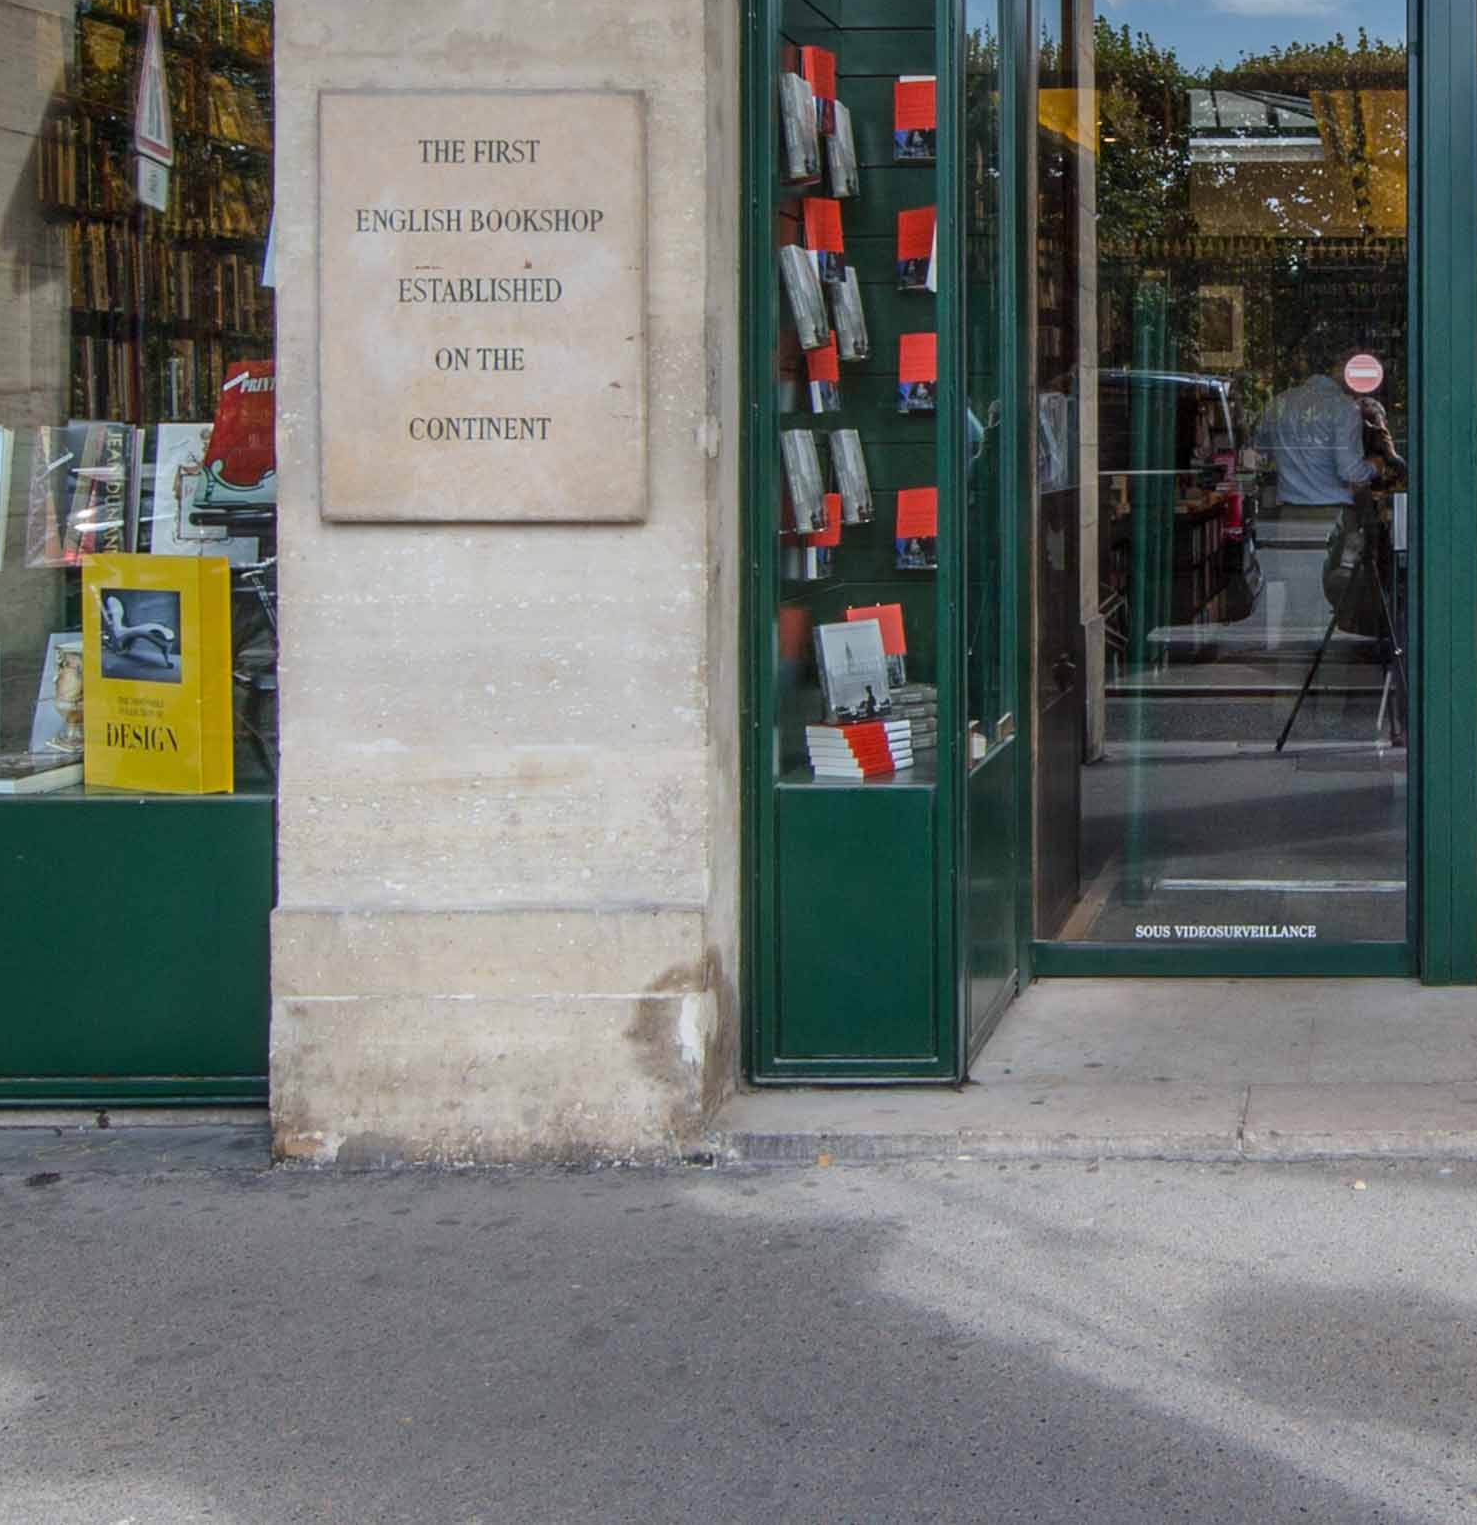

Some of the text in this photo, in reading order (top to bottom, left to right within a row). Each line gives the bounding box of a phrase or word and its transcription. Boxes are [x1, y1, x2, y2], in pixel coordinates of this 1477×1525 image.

[417, 139, 540, 164] THE FIRST
[355, 209, 604, 233] ENGLISH BOOKSHOP
[397, 278, 562, 303] ESTABLISHED
[435, 347, 525, 371] ON THE
[409, 417, 552, 441] CONTINENT
[106, 721, 179, 752] DESIGN
[1134, 925, 1317, 939] SOUS VIDEOSURVEILLANCE
